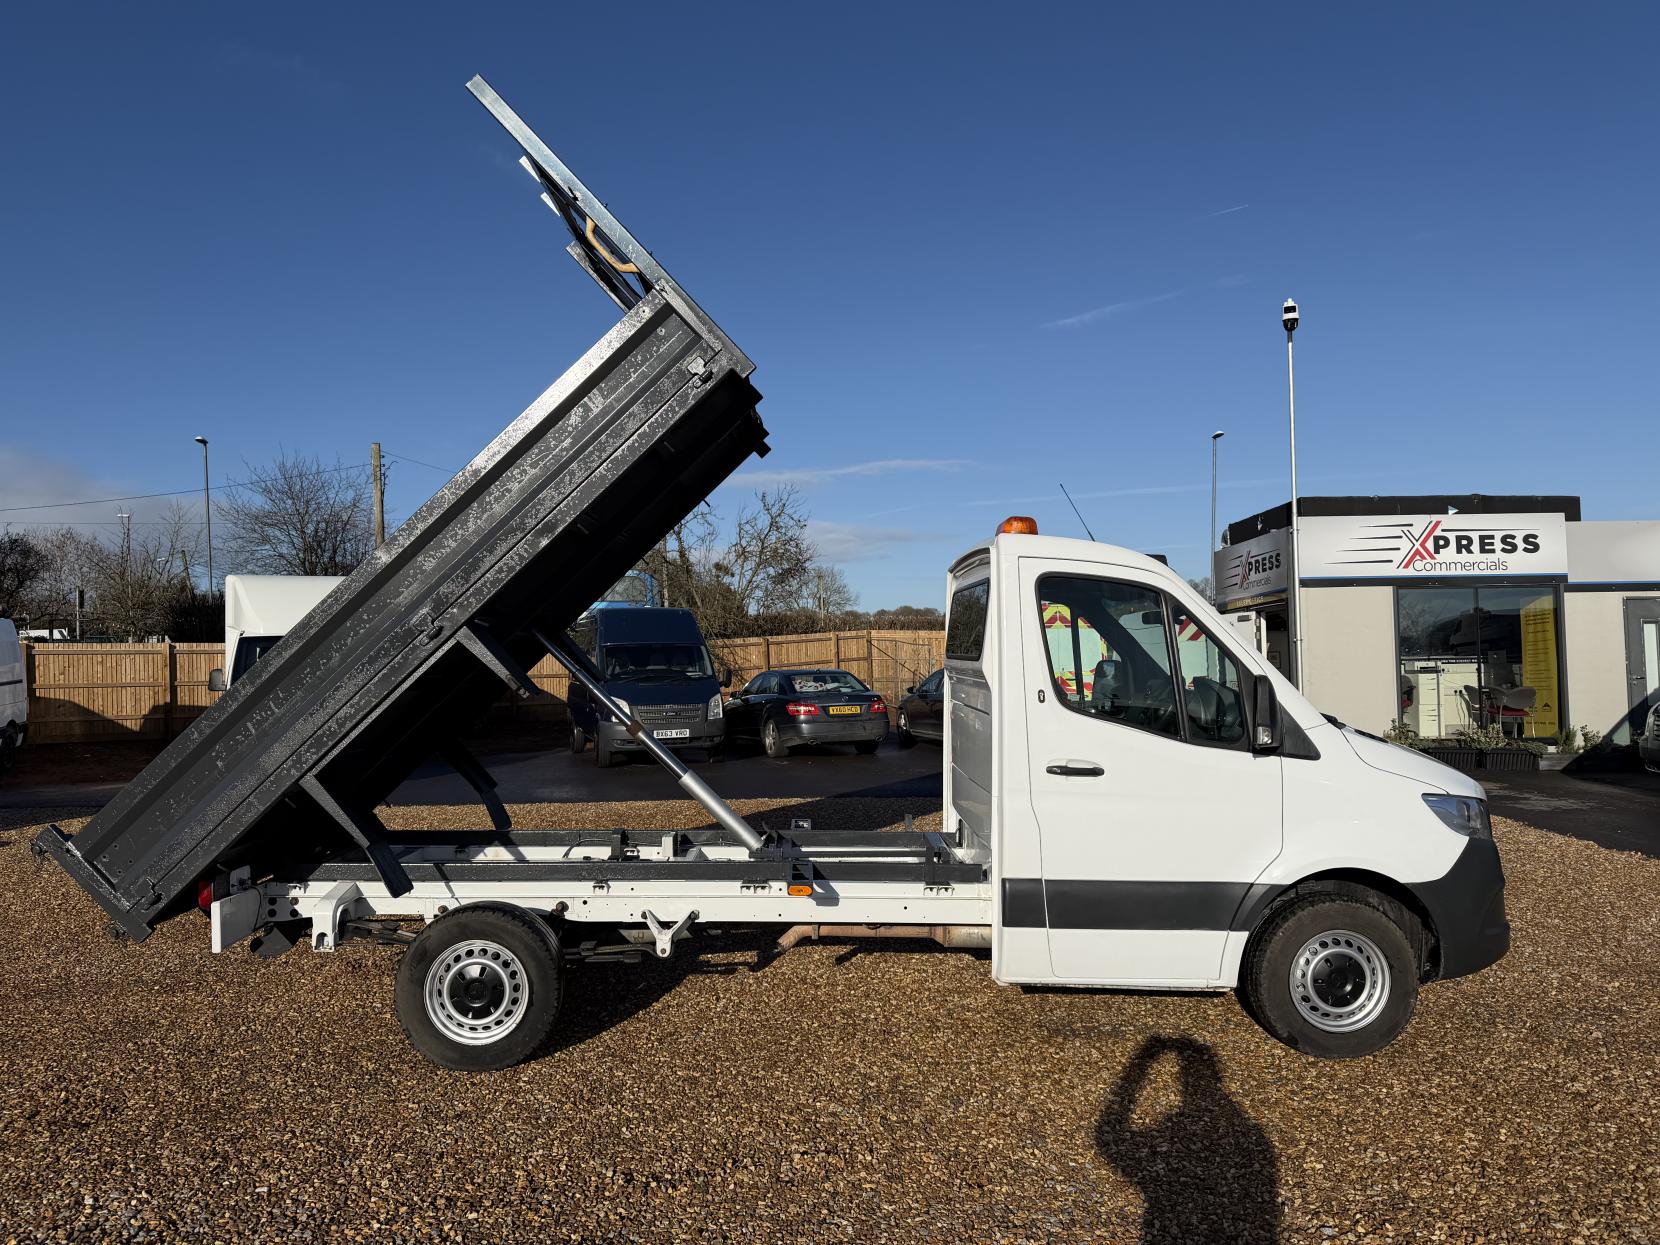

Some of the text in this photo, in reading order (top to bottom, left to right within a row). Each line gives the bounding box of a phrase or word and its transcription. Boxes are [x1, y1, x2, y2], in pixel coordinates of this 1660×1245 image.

[1397, 520, 1541, 569] XPRESS
[1239, 550, 1281, 589] XPRESS
[1412, 557, 1508, 572] Commercials
